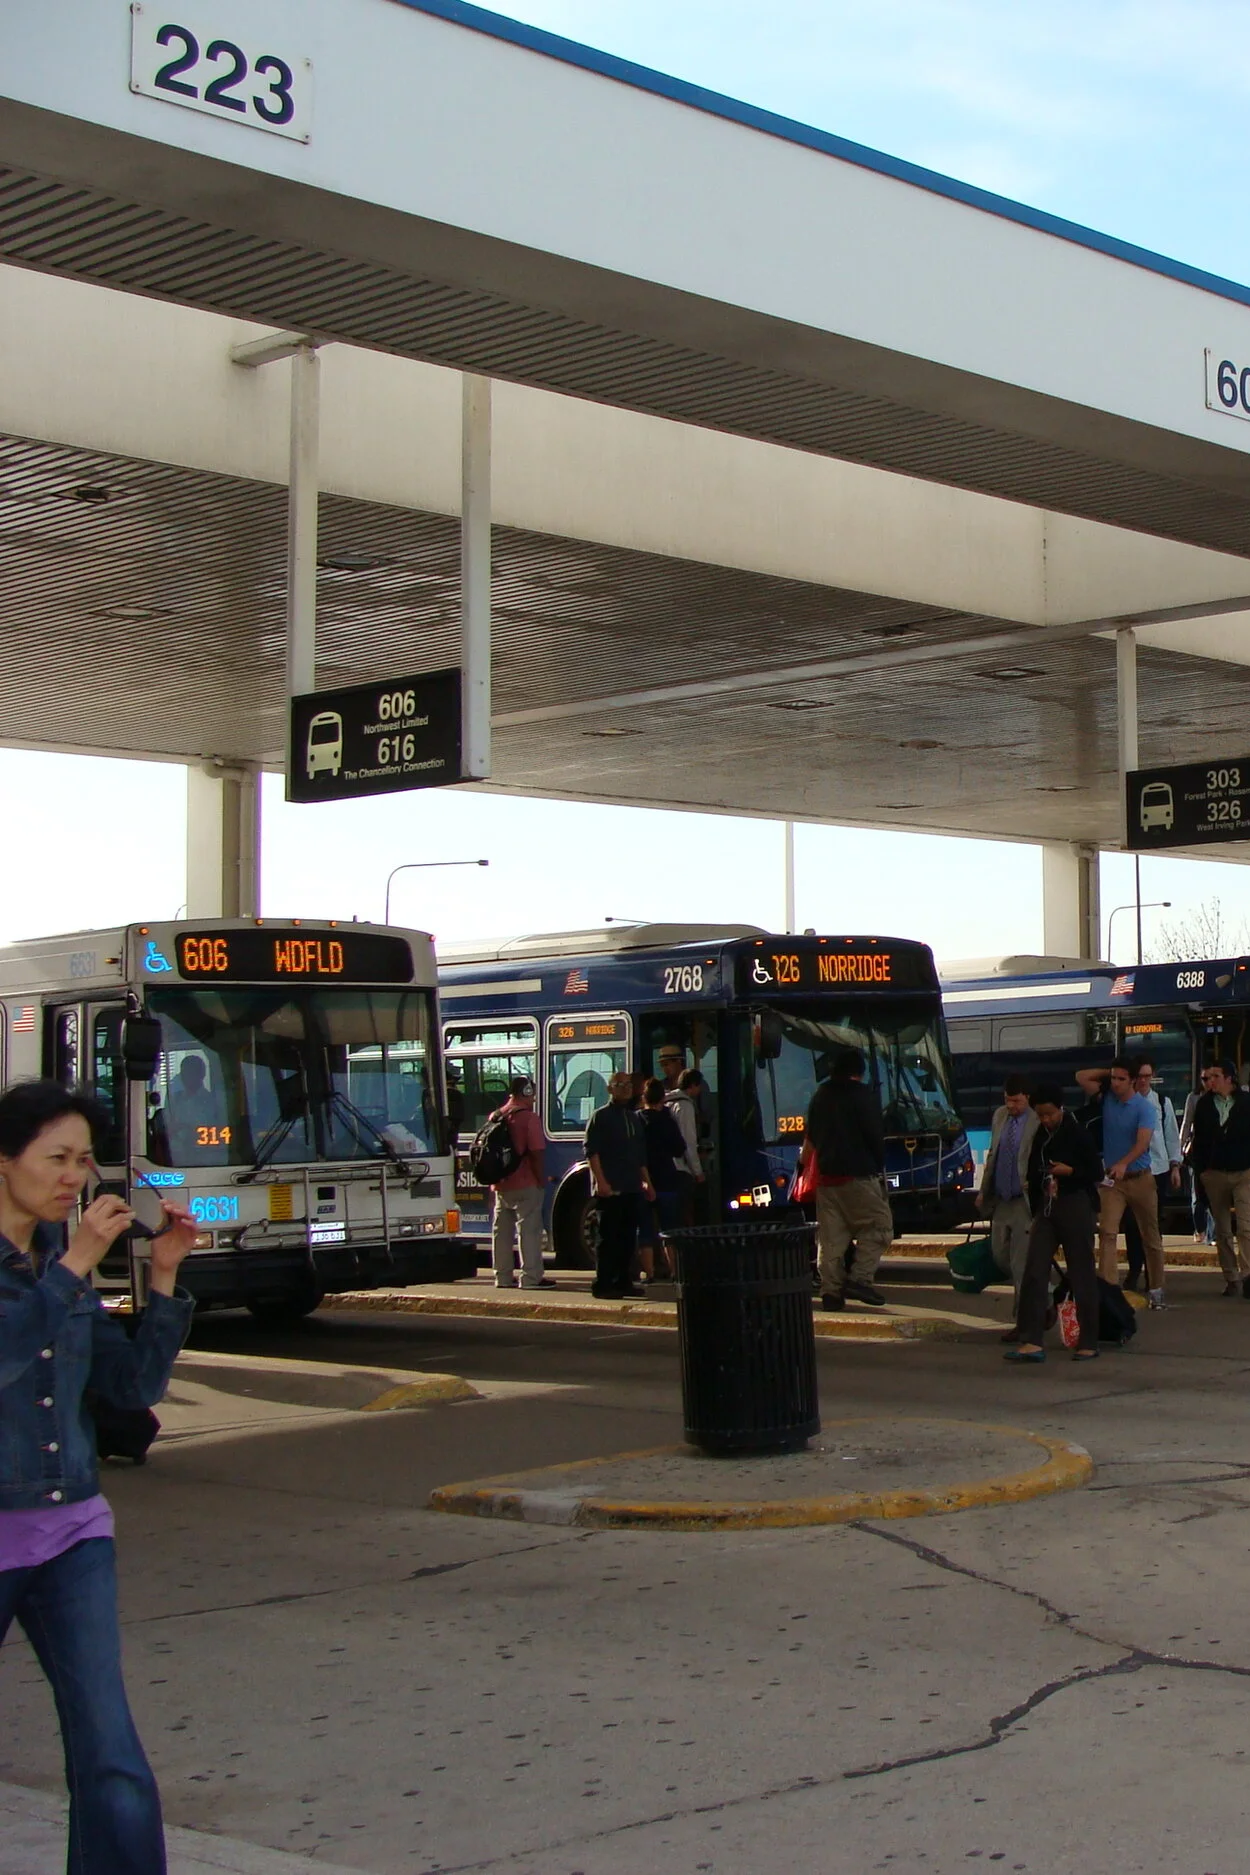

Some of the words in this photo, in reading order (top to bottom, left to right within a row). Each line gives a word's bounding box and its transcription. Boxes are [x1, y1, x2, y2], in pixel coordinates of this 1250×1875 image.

[154, 24, 295, 125] 223
[378, 690, 416, 720] 606
[363, 721, 401, 735] Northwest
[401, 715, 429, 729] Limited
[377, 733, 415, 764] 616
[344, 770, 357, 780] The
[403, 758, 446, 773] Connection
[1206, 768, 1240, 790] 303
[1207, 789, 1223, 799] Park
[1207, 800, 1241, 822] 326
[184, 938, 229, 972] 606
[274, 940, 345, 973] WDFLD
[664, 965, 703, 994] 2768
[818, 955, 892, 982] NORRIDGE
[1176, 970, 1205, 989] 6388
[558, 1026, 575, 1038] 326
[778, 1116, 805, 1132] 328
[196, 1126, 232, 1146] 314
